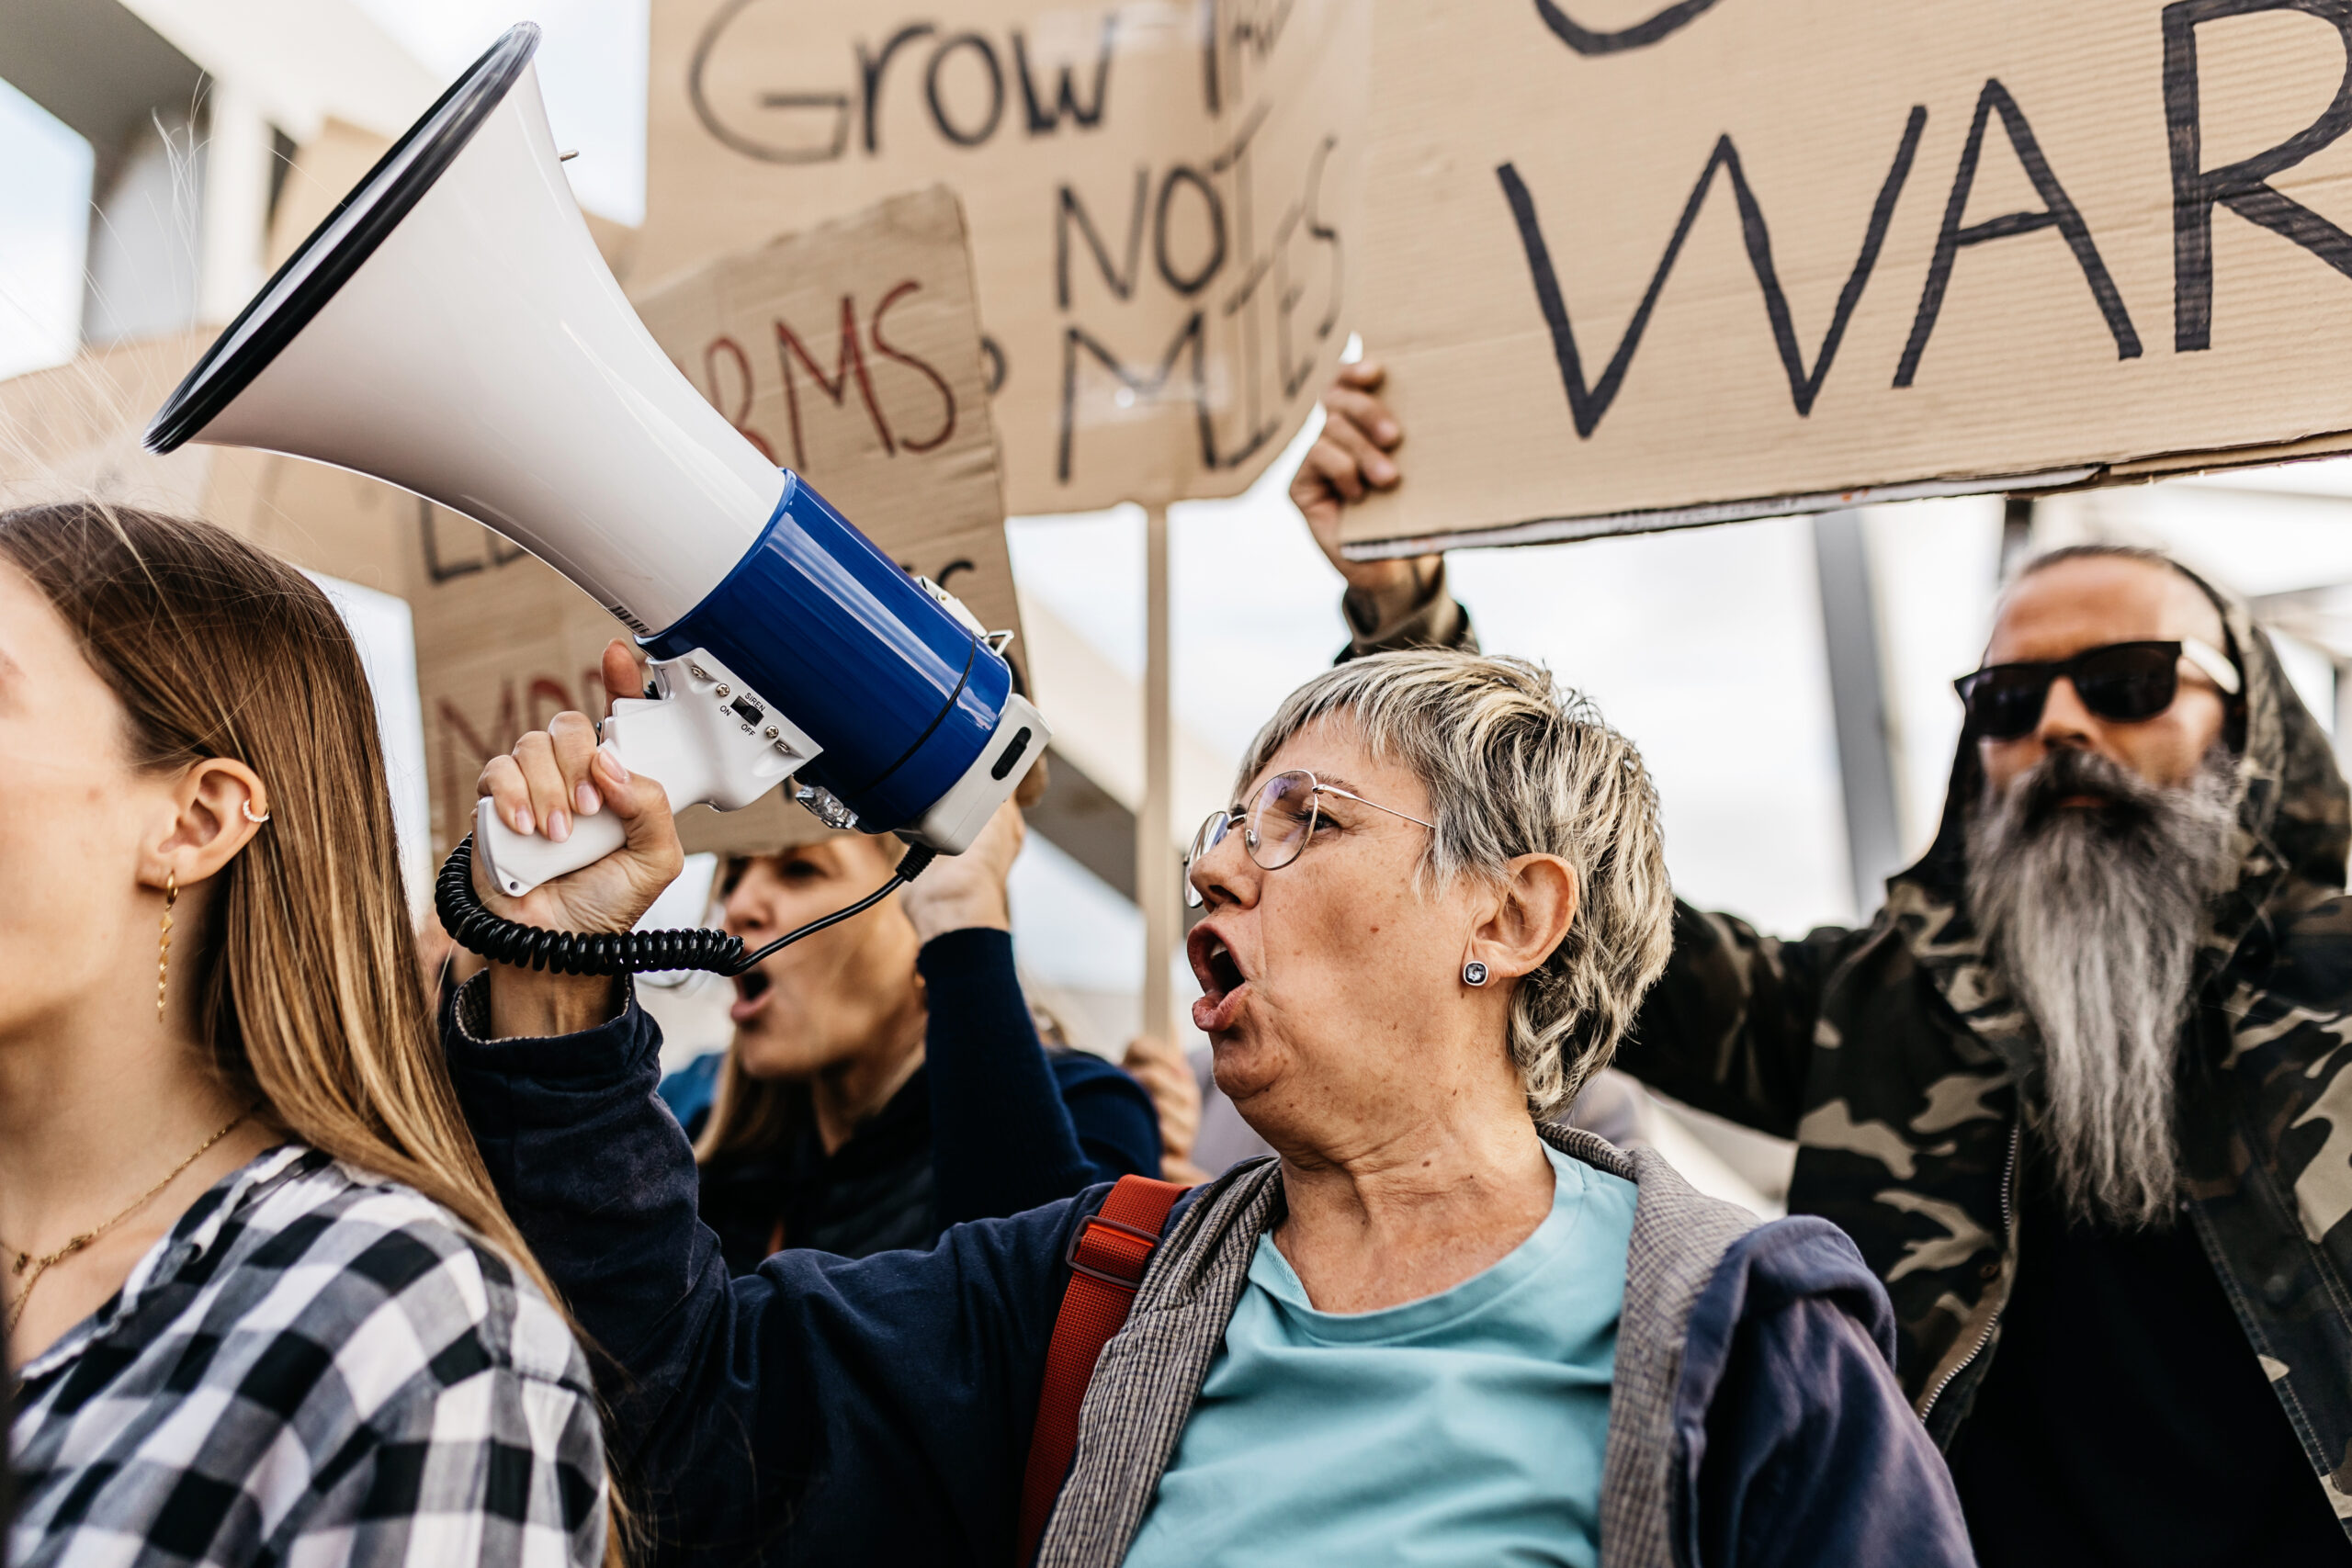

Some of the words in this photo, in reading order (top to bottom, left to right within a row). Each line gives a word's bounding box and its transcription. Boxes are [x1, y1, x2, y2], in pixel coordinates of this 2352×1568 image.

[1057, 98, 1274, 310] NOT
[1497, 0, 2352, 439] WAR
[680, 279, 956, 472] RMS
[719, 705, 731, 716] ON
[741, 724, 755, 736] OFF
[745, 693, 765, 712] SIREN
